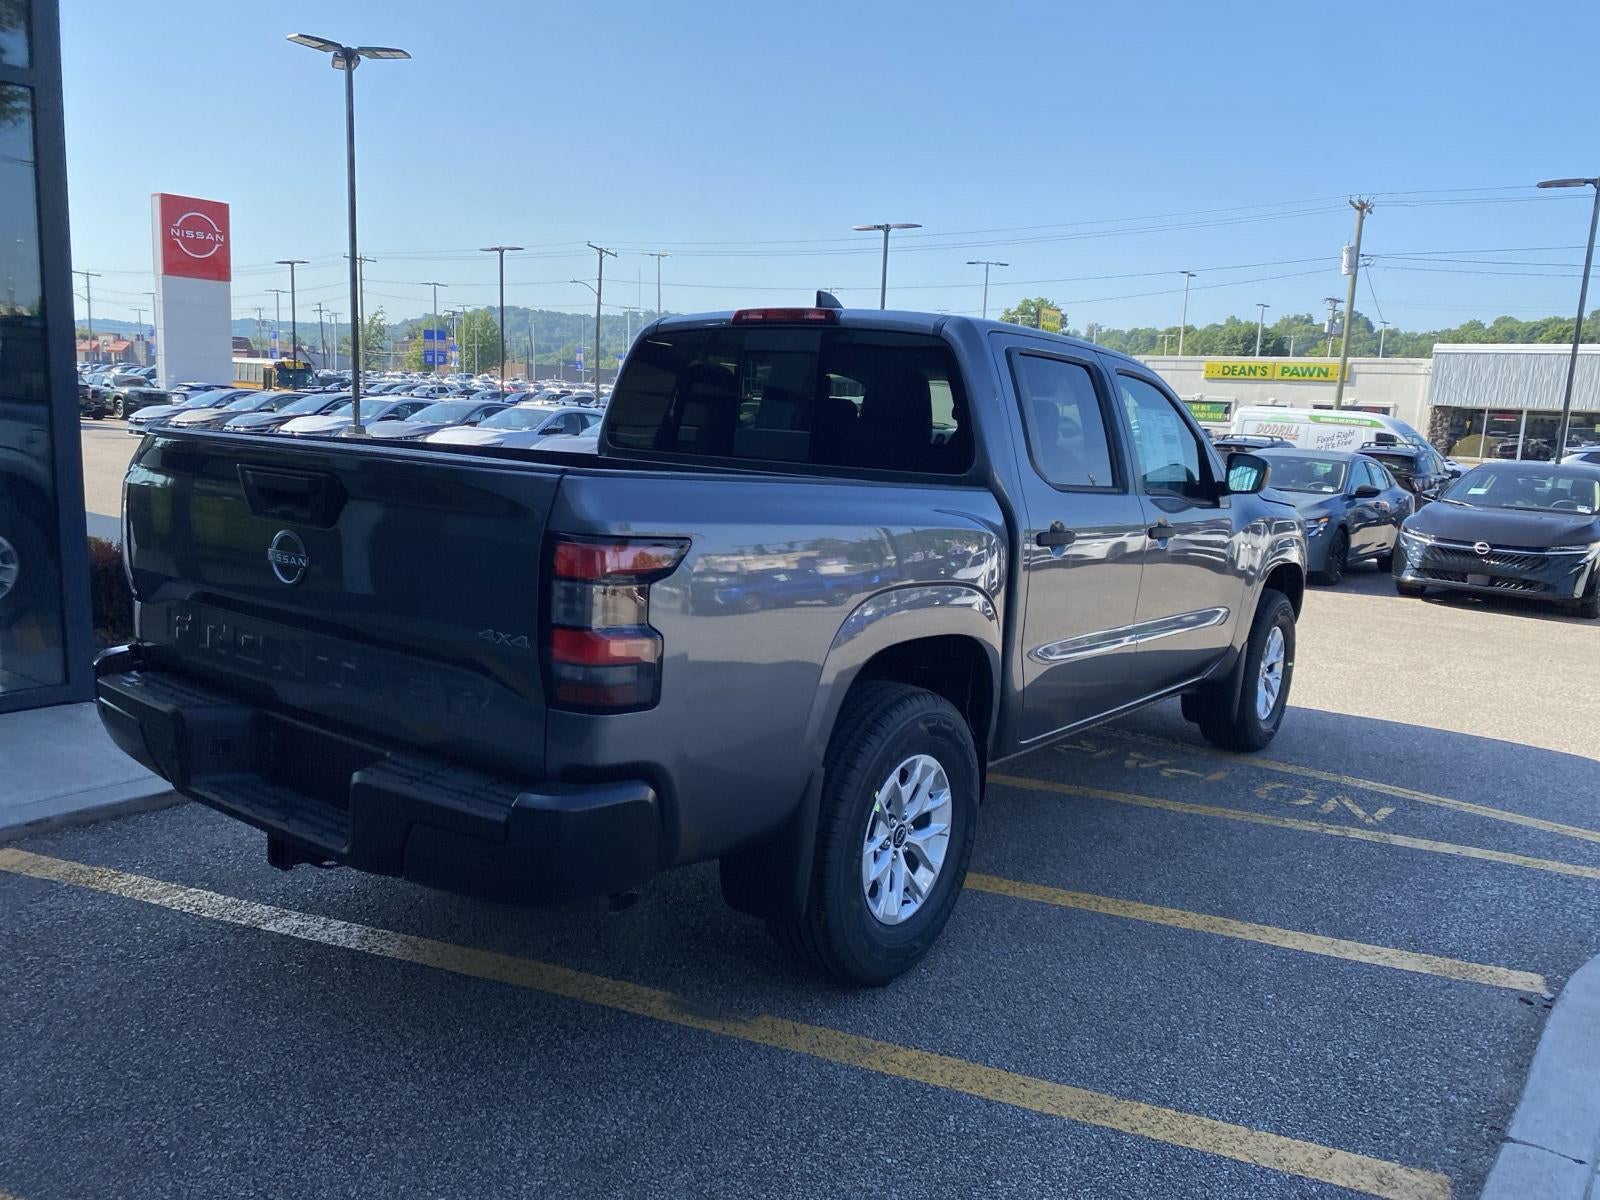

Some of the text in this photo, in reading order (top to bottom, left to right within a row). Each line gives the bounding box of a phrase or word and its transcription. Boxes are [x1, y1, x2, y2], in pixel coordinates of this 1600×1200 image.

[170, 228, 224, 242] NISSAN
[1221, 365, 1330, 378] DEAN'S PAWN
[1255, 422, 1300, 435] DODRILL
[1337, 429, 1355, 440] Right
[1337, 439, 1353, 447] Free
